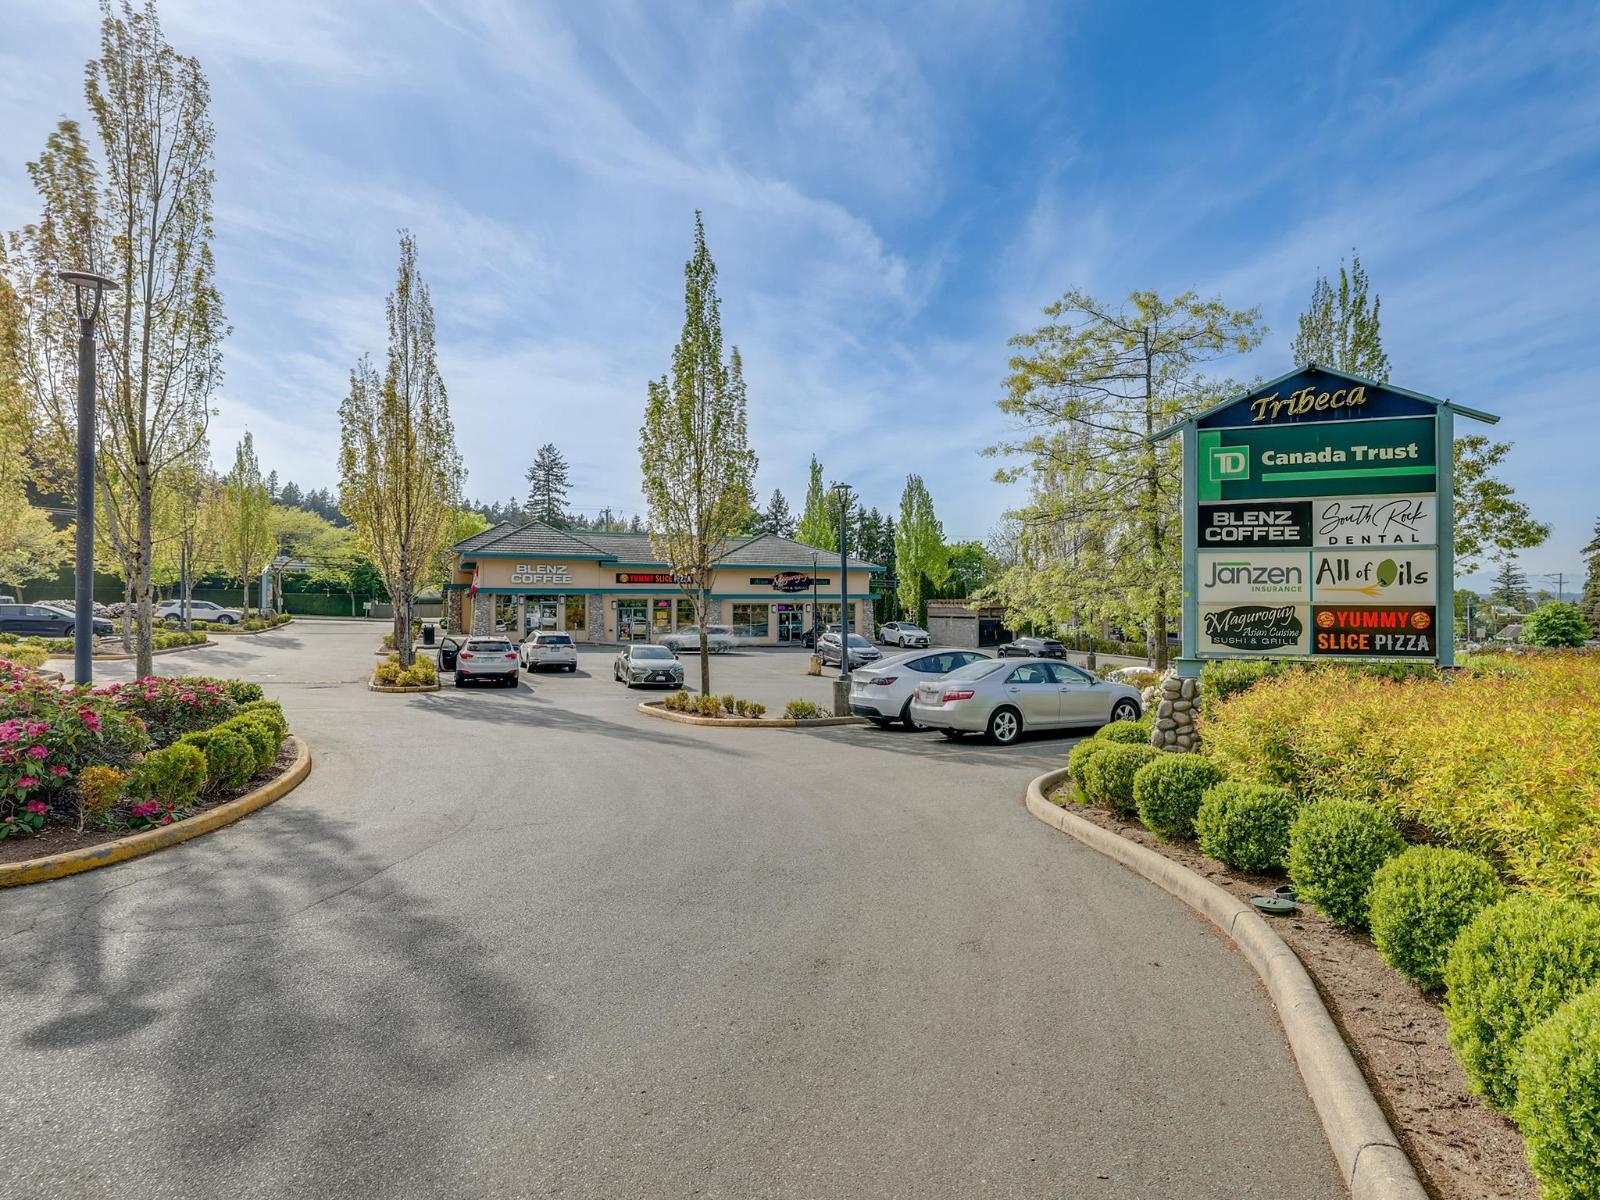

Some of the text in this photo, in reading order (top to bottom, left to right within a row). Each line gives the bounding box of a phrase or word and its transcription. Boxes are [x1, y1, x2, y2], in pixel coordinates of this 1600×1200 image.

[1251, 386, 1367, 422] Tribeca
[1213, 442, 1418, 474] TD Canada Trust
[1213, 510, 1292, 526] BLENZ
[1319, 500, 1428, 535] South Rock
[1205, 526, 1300, 541] COFFEE
[1328, 534, 1420, 545] DENTAL
[516, 564, 568, 574] BLENZ
[1204, 562, 1302, 588] Janzen
[1315, 558, 1349, 585] All
[1356, 562, 1373, 581] of
[511, 574, 573, 584] COFFEE
[655, 574, 673, 583] SLICE
[1251, 585, 1302, 593] INSURANCE
[1204, 606, 1294, 634] Maguroguy
[1337, 611, 1409, 628] YUMMY
[1242, 626, 1299, 637] Asian Cuisine
[1250, 637, 1258, 645] &
[1261, 637, 1296, 645] GRILL
[1318, 633, 1430, 651] SLICE PIZZA
